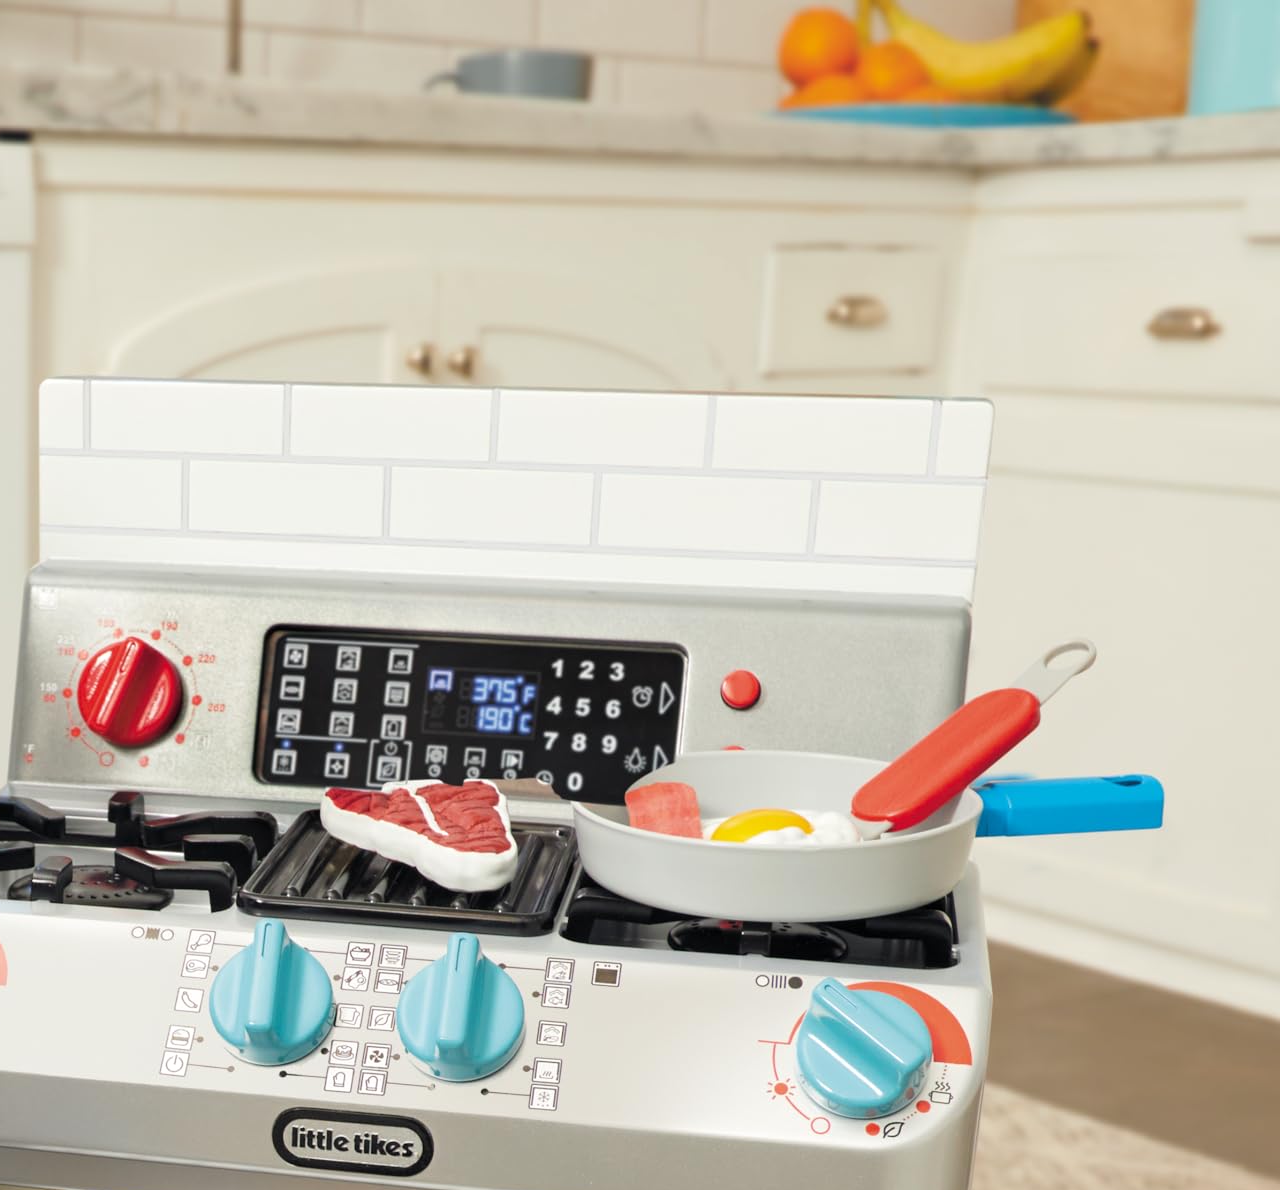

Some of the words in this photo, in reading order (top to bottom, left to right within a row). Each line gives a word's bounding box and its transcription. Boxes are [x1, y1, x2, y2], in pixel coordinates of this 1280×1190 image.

[160, 620, 178, 632] 190
[198, 653, 216, 664] 220
[551, 658, 565, 679] 1
[578, 660, 595, 680] 2
[609, 661, 625, 682] 3
[545, 695, 562, 716] 4
[575, 697, 592, 717] 5
[605, 699, 621, 719] 6
[543, 731, 559, 751] 7
[571, 732, 587, 752] 8
[601, 734, 618, 754] 9
[567, 771, 583, 792] 0
[291, 1126, 350, 1152] little
[353, 1132, 415, 1158] tikes
